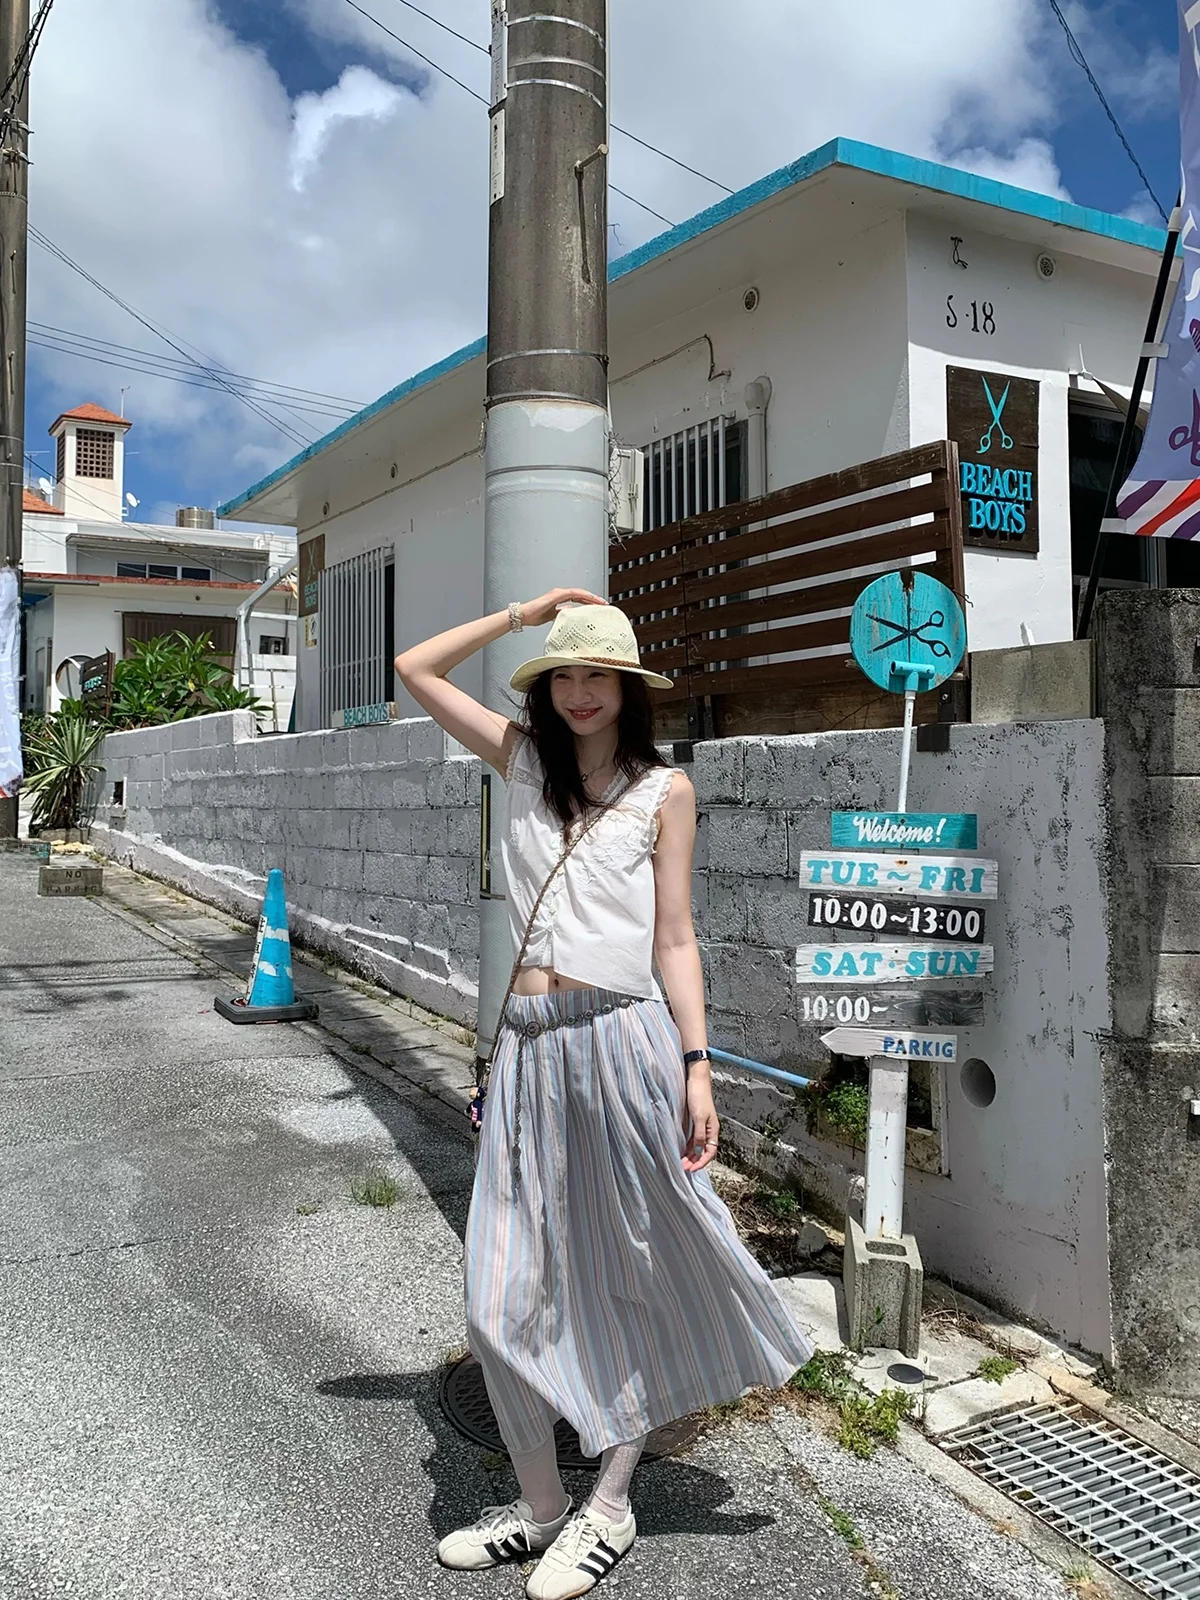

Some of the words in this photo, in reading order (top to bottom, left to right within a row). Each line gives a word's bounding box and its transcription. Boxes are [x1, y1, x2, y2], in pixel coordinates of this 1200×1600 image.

[960, 462, 1033, 501] BEACH
[968, 498, 1026, 534] BOYS
[344, 706, 366, 726] BEACH
[369, 703, 388, 722] BOYS
[853, 818, 947, 843] Welcome!
[65, 870, 82, 879] NO
[813, 897, 981, 938] 10:00~13:00
[883, 1035, 954, 1058] PARKIG
